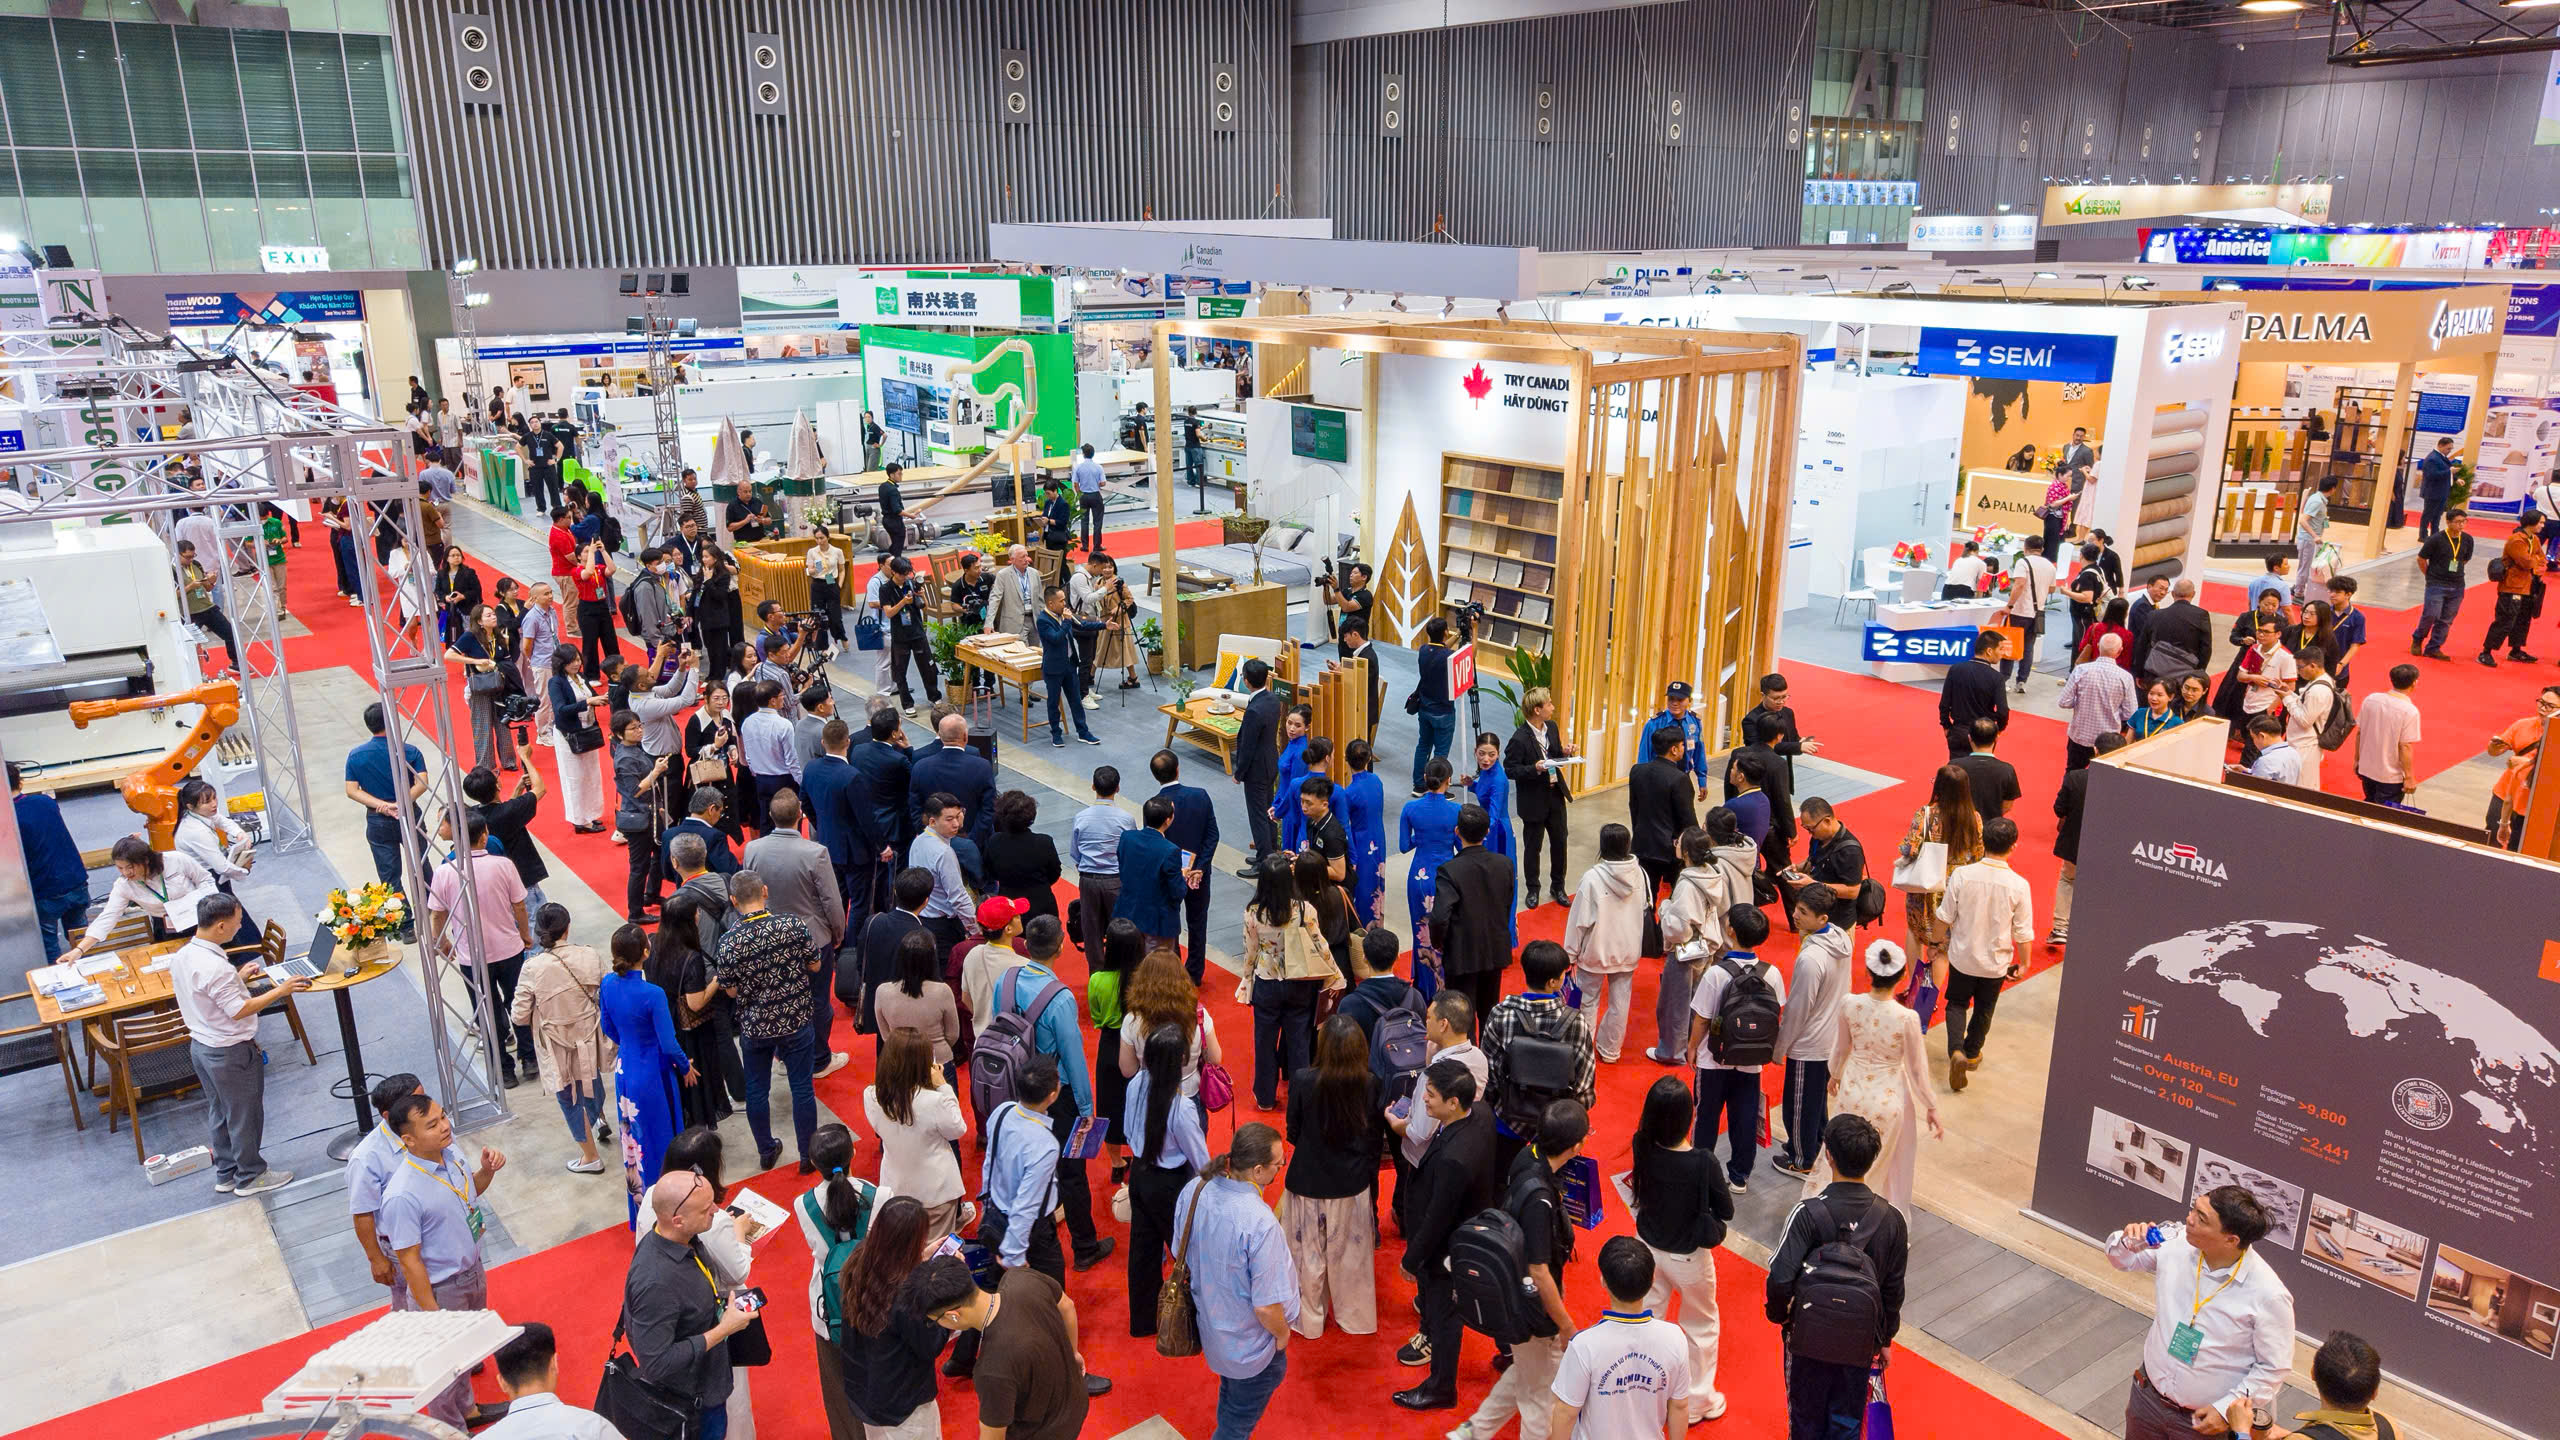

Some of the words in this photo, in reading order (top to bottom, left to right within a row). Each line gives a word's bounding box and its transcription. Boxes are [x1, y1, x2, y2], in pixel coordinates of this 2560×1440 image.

[2083, 206, 2121, 215] GROWN
[268, 251, 320, 264] EXIT
[1196, 245, 1223, 256] Canadian
[2205, 238, 2272, 257] America
[1196, 255, 1213, 266] Wood
[167, 296, 222, 306] namWOOD
[906, 291, 978, 310] 南兴装备
[2510, 297, 2540, 305] TIONS
[2242, 314, 2373, 342] PALMA
[2451, 306, 2496, 335] PALMA
[909, 360, 933, 376] 南兴装备
[1987, 344, 2056, 368] SEMI
[1504, 374, 1525, 387] TRY
[1503, 394, 1526, 408] HÃY
[1526, 395, 1560, 412] DÙNG
[1827, 430, 1846, 439] 2000+
[1993, 500, 2036, 514] PALMA
[1905, 638, 1971, 657] SEMI
[1455, 655, 1472, 689] VIP
[2131, 841, 2229, 880] AUSTRIA
[2135, 858, 2164, 871] Premium
[2164, 866, 2195, 880] Furniture
[2196, 875, 2222, 888] Fittings
[2122, 990, 2142, 1000] Market
[2142, 997, 2163, 1008] position
[2113, 1056, 2135, 1069] Present
[2144, 1064, 2176, 1084] Over
[2181, 1077, 2204, 1094] 120
[2115, 1039, 2154, 1058] Headquarters
[2163, 1052, 2216, 1081] Austria,
[2217, 1071, 2239, 1088] EU
[2110, 1073, 2127, 1085] Holds
[2127, 1080, 2142, 1090] more
[2143, 1086, 2156, 1095] than
[2158, 1087, 2194, 1109] 2,100
[2195, 1105, 2219, 1119] Patents
[2260, 1084, 2296, 1102] Employees
[2396, 1081, 2418, 1096] LIFETIME
[2418, 1081, 2449, 1105] WARRANTY
[2256, 1109, 2277, 1122] Global
[2278, 1117, 2309, 1133] Turnover:
[2266, 1095, 2288, 1106] global:
[2298, 1100, 2348, 1127] >9,800
[2396, 1103, 2426, 1127] WARRANTY
[2426, 1112, 2449, 1128] LIFETIME
[2384, 1129, 2404, 1141] Blum
[2404, 1136, 2439, 1152] Vietnam
[2436, 1148, 2457, 1161] offers
[2465, 1157, 2496, 1174] Lifetime
[2497, 1168, 2534, 1188] Warranty
[2393, 1142, 2406, 1152] the
[2406, 1147, 2451, 1170] functionality
[2460, 1167, 2474, 1176] our
[2474, 1171, 2519, 1193] mechanical
[2097, 1172, 2125, 1187] SYSTEMS
[2378, 1156, 2405, 1171] lifetime
[2415, 1169, 2427, 1179] the
[2470, 1188, 2503, 1208] furniture
[2503, 1203, 2535, 1219] cabinet.
[2380, 1148, 2414, 1165] products.
[2415, 1159, 2432, 1171] This
[2432, 1167, 2465, 1183] warranty
[2465, 1178, 2494, 1194] applies
[2494, 1187, 2506, 1198] for
[2507, 1193, 2521, 1203] the
[2377, 1165, 2391, 1175] For
[2391, 1169, 2417, 1185] electric
[2417, 1179, 2450, 1198] products
[2451, 1192, 2466, 1203] and
[2467, 1199, 2516, 1223] components,
[2382, 1176, 2405, 1191] 5-year
[2406, 1185, 2438, 1203] warranty
[2447, 1202, 2482, 1220] provided.
[2300, 1258, 2329, 1274] RUNNER
[2329, 1270, 2362, 1289] SYSTEMS
[2424, 1311, 2455, 1328] POCKET
[2455, 1324, 2491, 1344] SYSTEMS
[1616, 1373, 1653, 1386] HCMUTE
